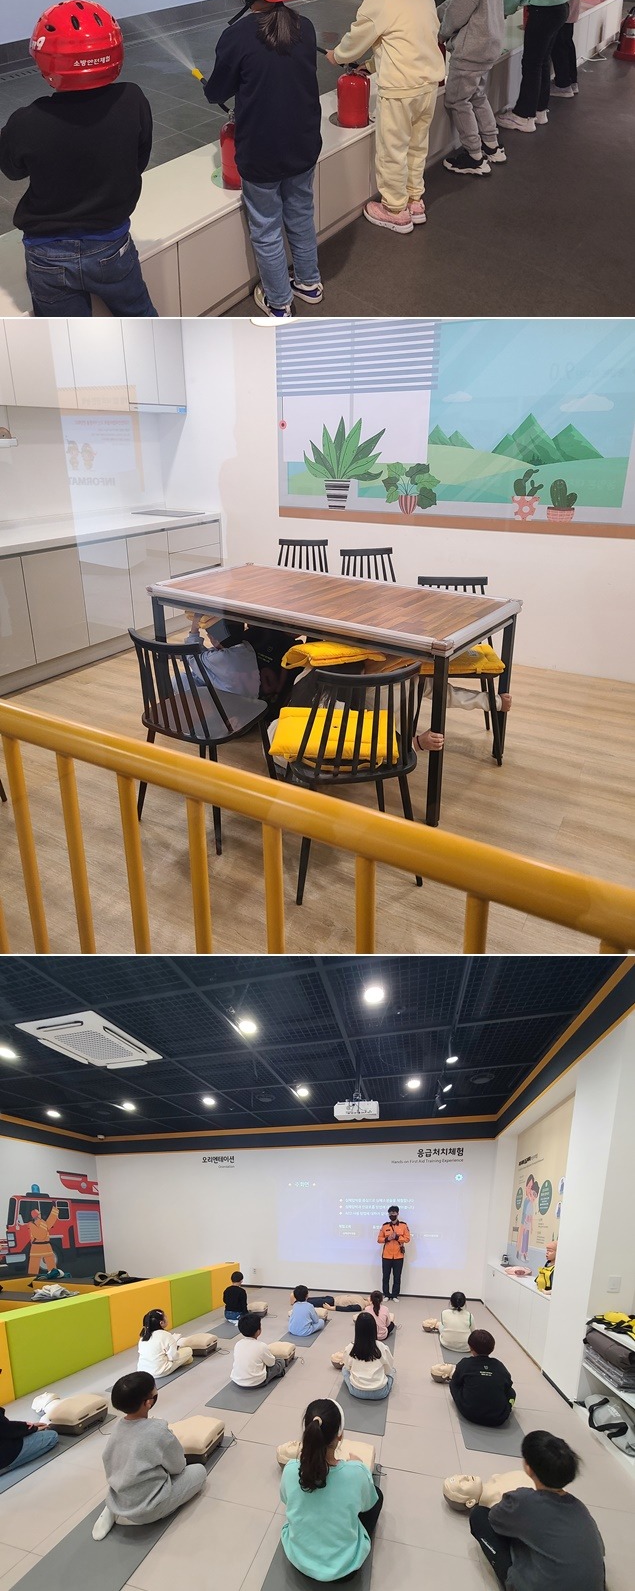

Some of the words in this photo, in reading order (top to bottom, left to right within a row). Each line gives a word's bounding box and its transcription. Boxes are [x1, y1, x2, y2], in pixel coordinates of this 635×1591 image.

[73, 56, 110, 67] 소방안전체험
[417, 1147, 464, 1158] 응급처치체험
[202, 1156, 235, 1164] 오리엔테이션
